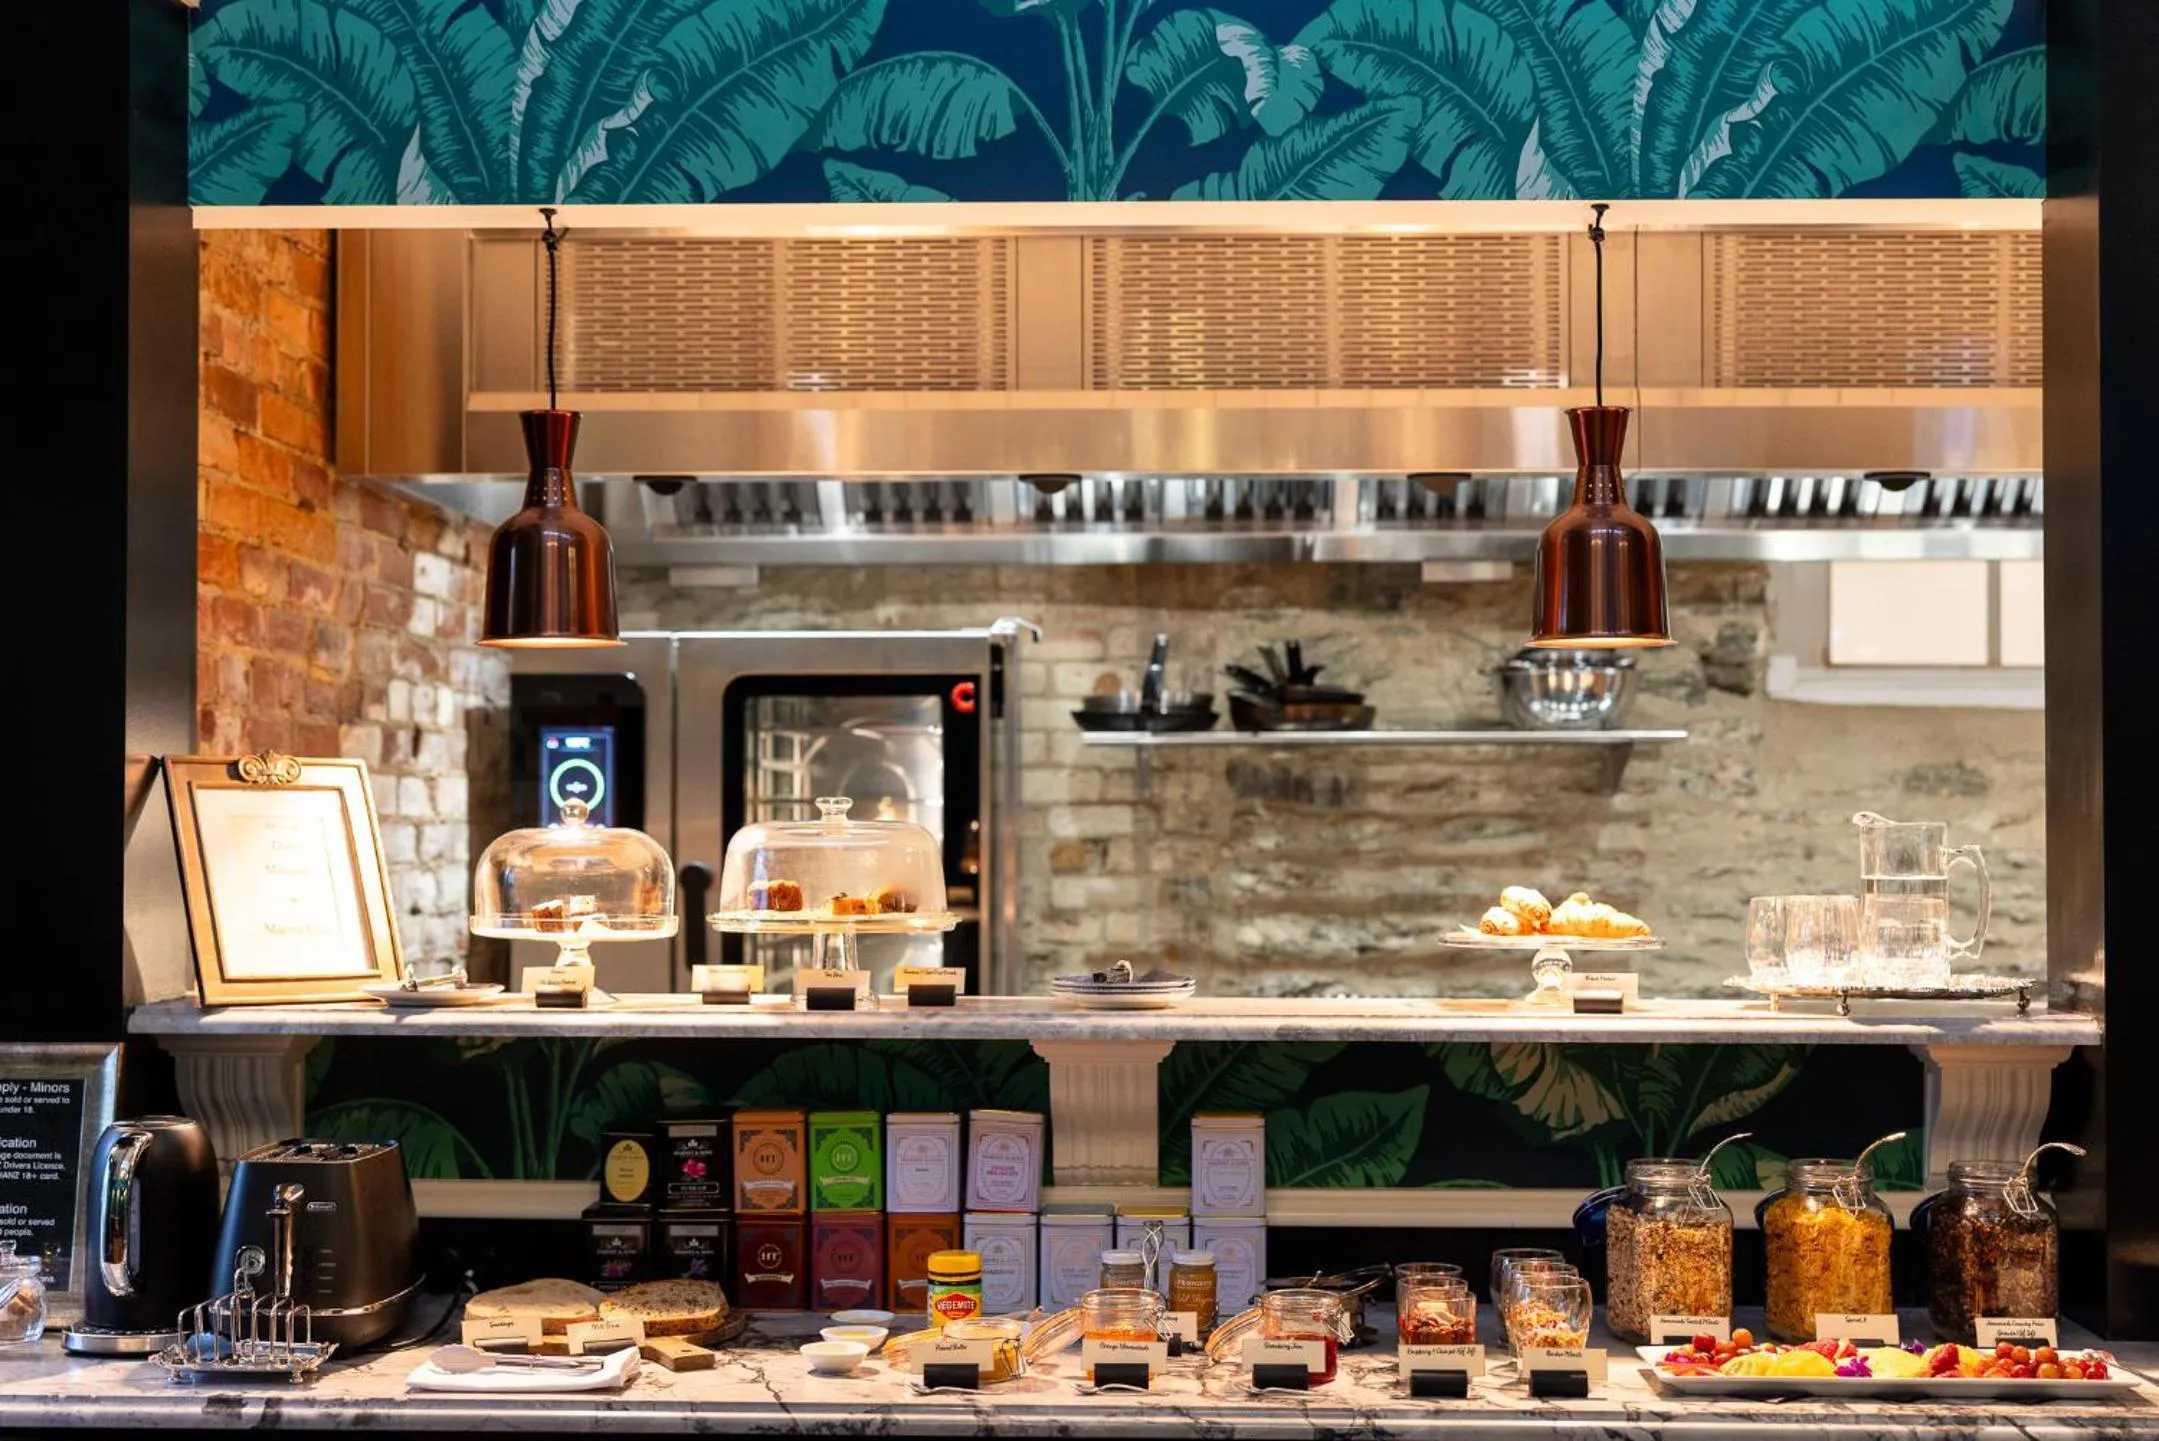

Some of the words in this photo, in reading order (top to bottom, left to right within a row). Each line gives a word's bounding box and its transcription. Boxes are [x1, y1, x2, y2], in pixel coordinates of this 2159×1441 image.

[0, 1082, 19, 1095] ply
[30, 1081, 70, 1094] Minors
[0, 1137, 37, 1149] cation
[28, 1217, 56, 1226] served
[936, 1301, 976, 1310] VEGEMITE
